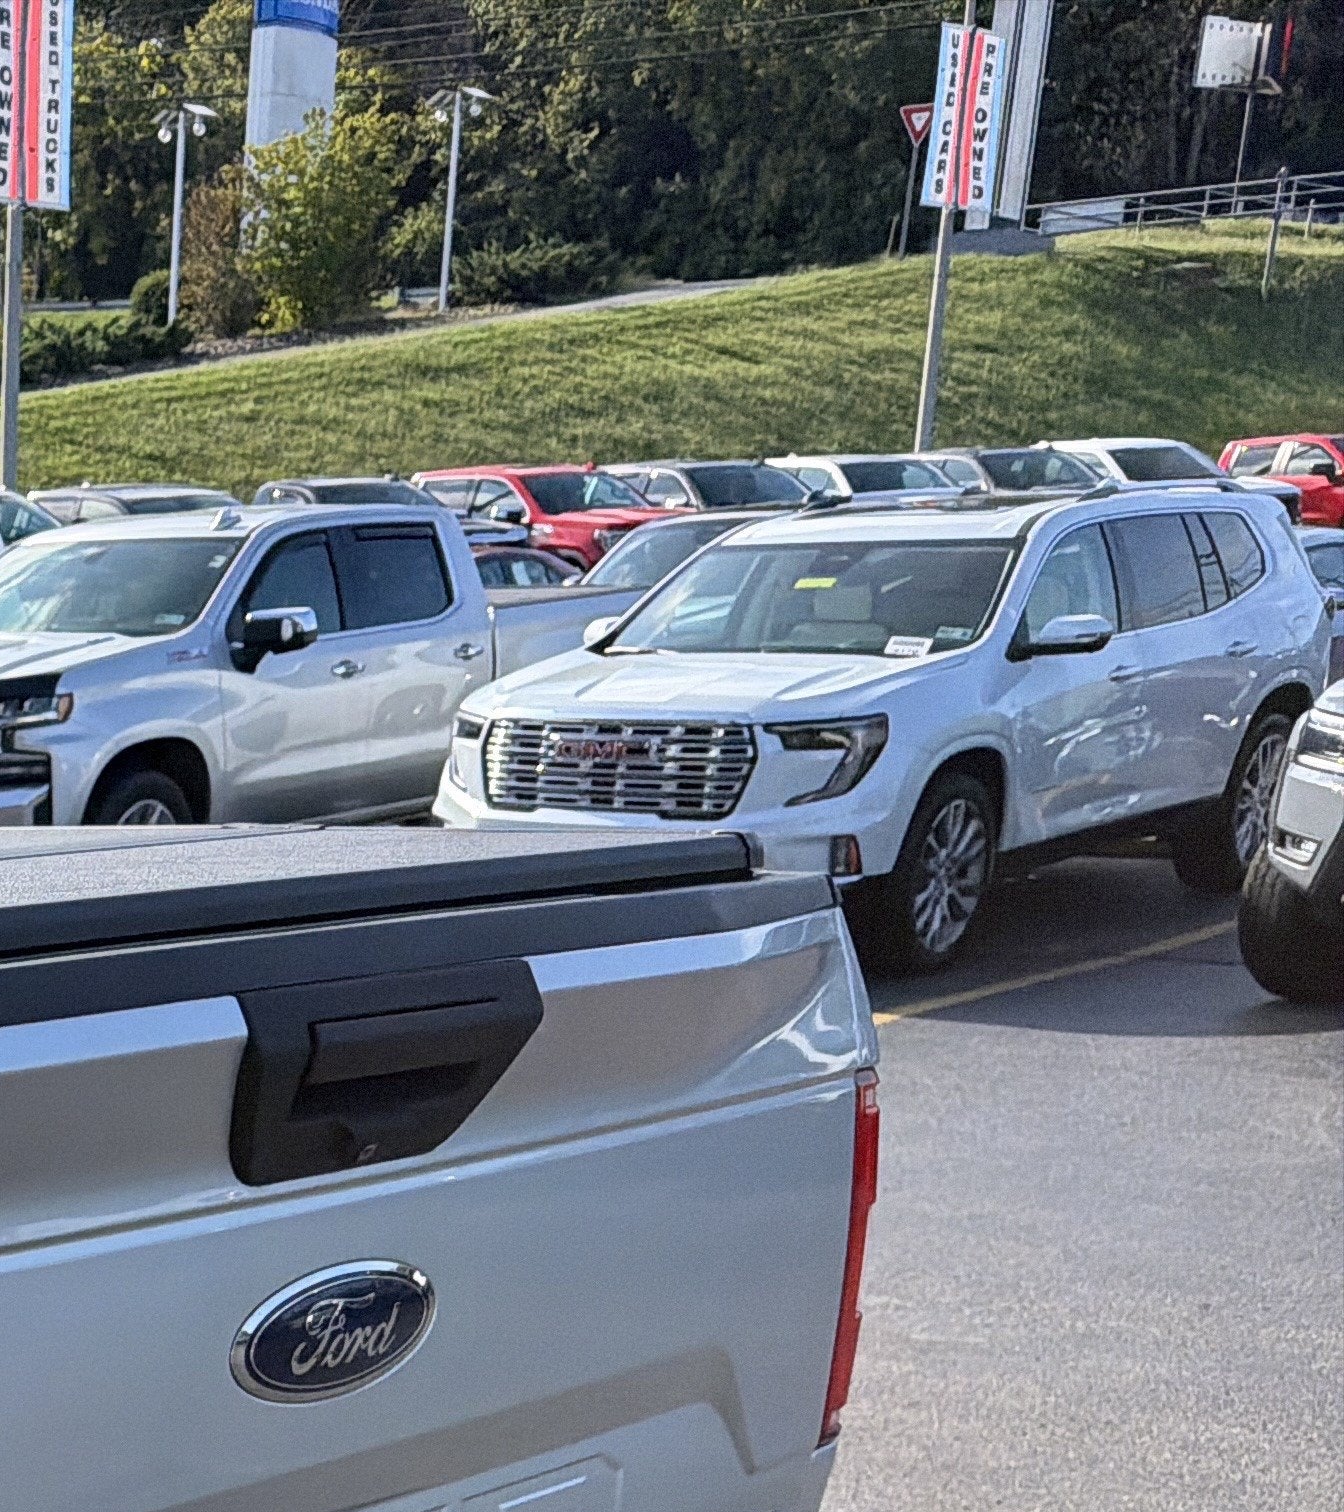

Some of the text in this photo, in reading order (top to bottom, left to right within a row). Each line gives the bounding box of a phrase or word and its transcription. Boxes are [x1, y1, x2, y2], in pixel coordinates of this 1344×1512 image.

[45, 79, 60, 193] TRUCKS
[934, 33, 960, 195] USED CARS
[972, 44, 996, 200] PRE OWNED
[290, 1291, 402, 1377] Ford
